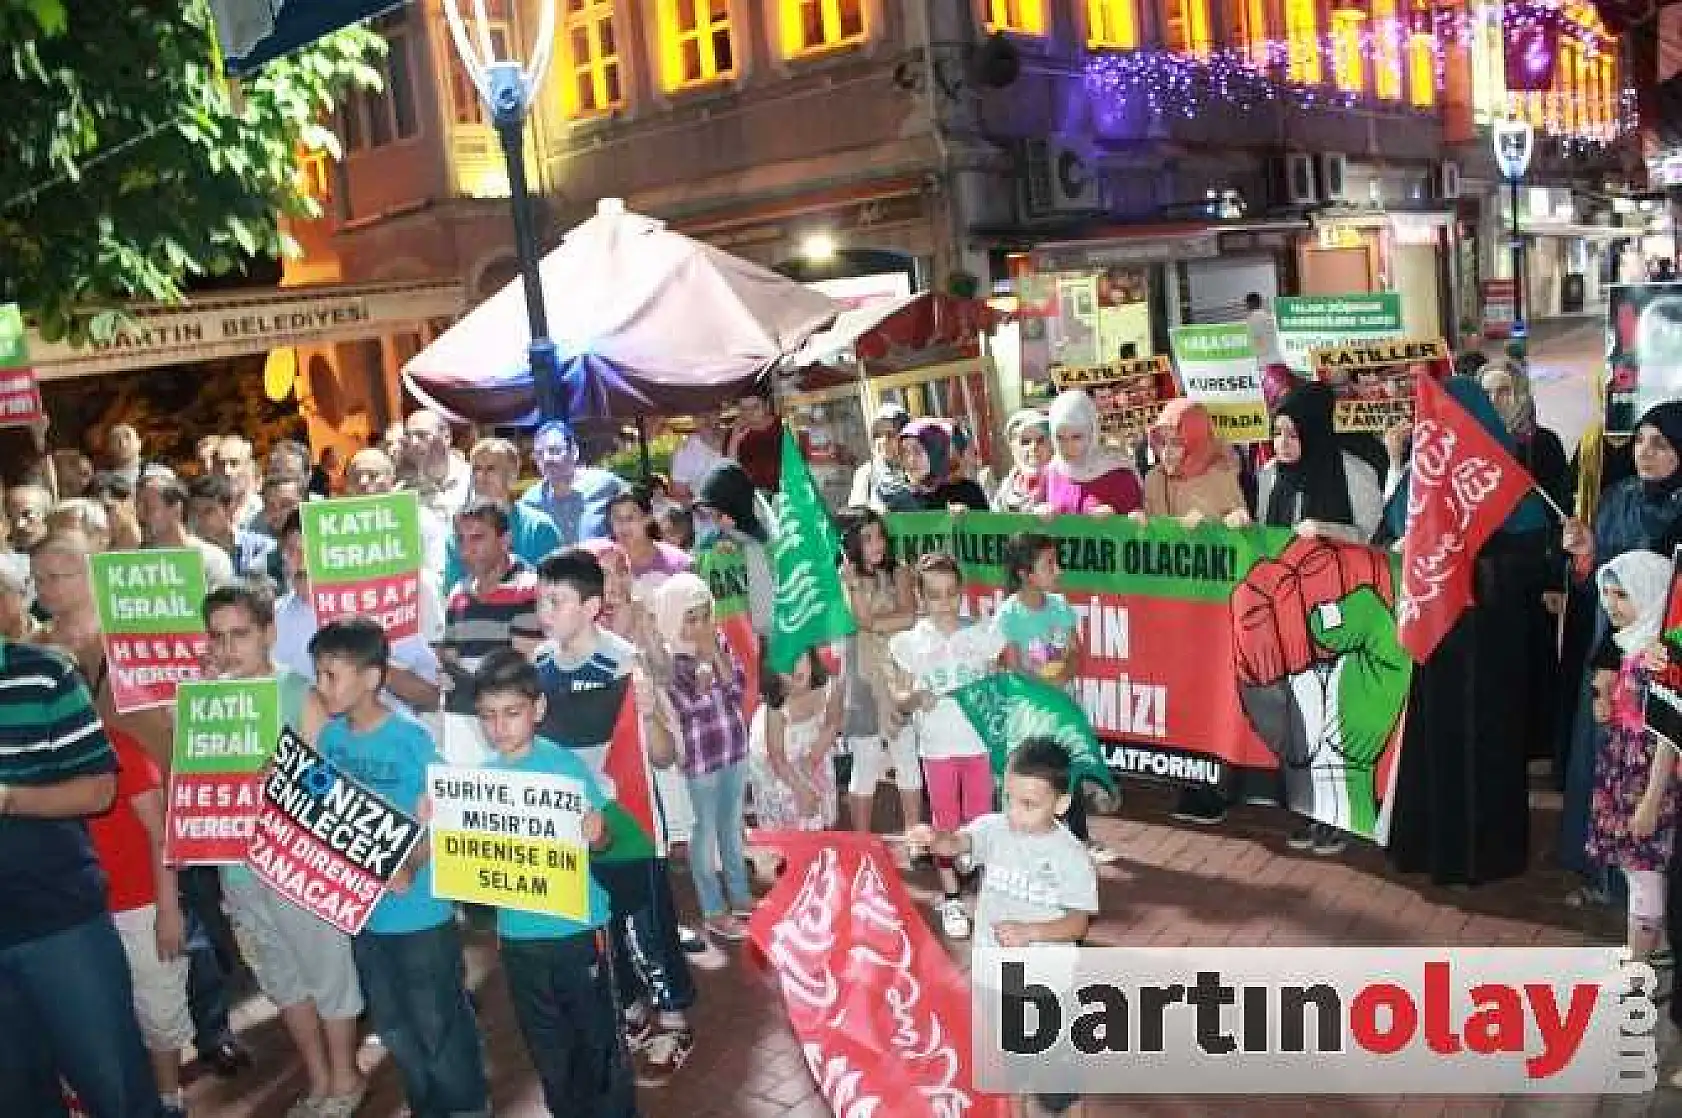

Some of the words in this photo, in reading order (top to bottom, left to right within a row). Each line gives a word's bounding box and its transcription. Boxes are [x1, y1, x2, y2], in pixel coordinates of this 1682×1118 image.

[97, 321, 201, 349] ARTIN
[318, 502, 399, 535] KATİL
[320, 533, 407, 570] İSRAİL
[1058, 538, 1116, 571] EZAR
[1124, 541, 1238, 582] OLACAK!
[108, 555, 186, 587] KATİL
[110, 590, 196, 620] İSRAİL
[189, 690, 261, 723] KATİL
[187, 723, 265, 760] İSRAİL
[1100, 744, 1221, 785] LATFORMU
[479, 868, 548, 897] SELAM
